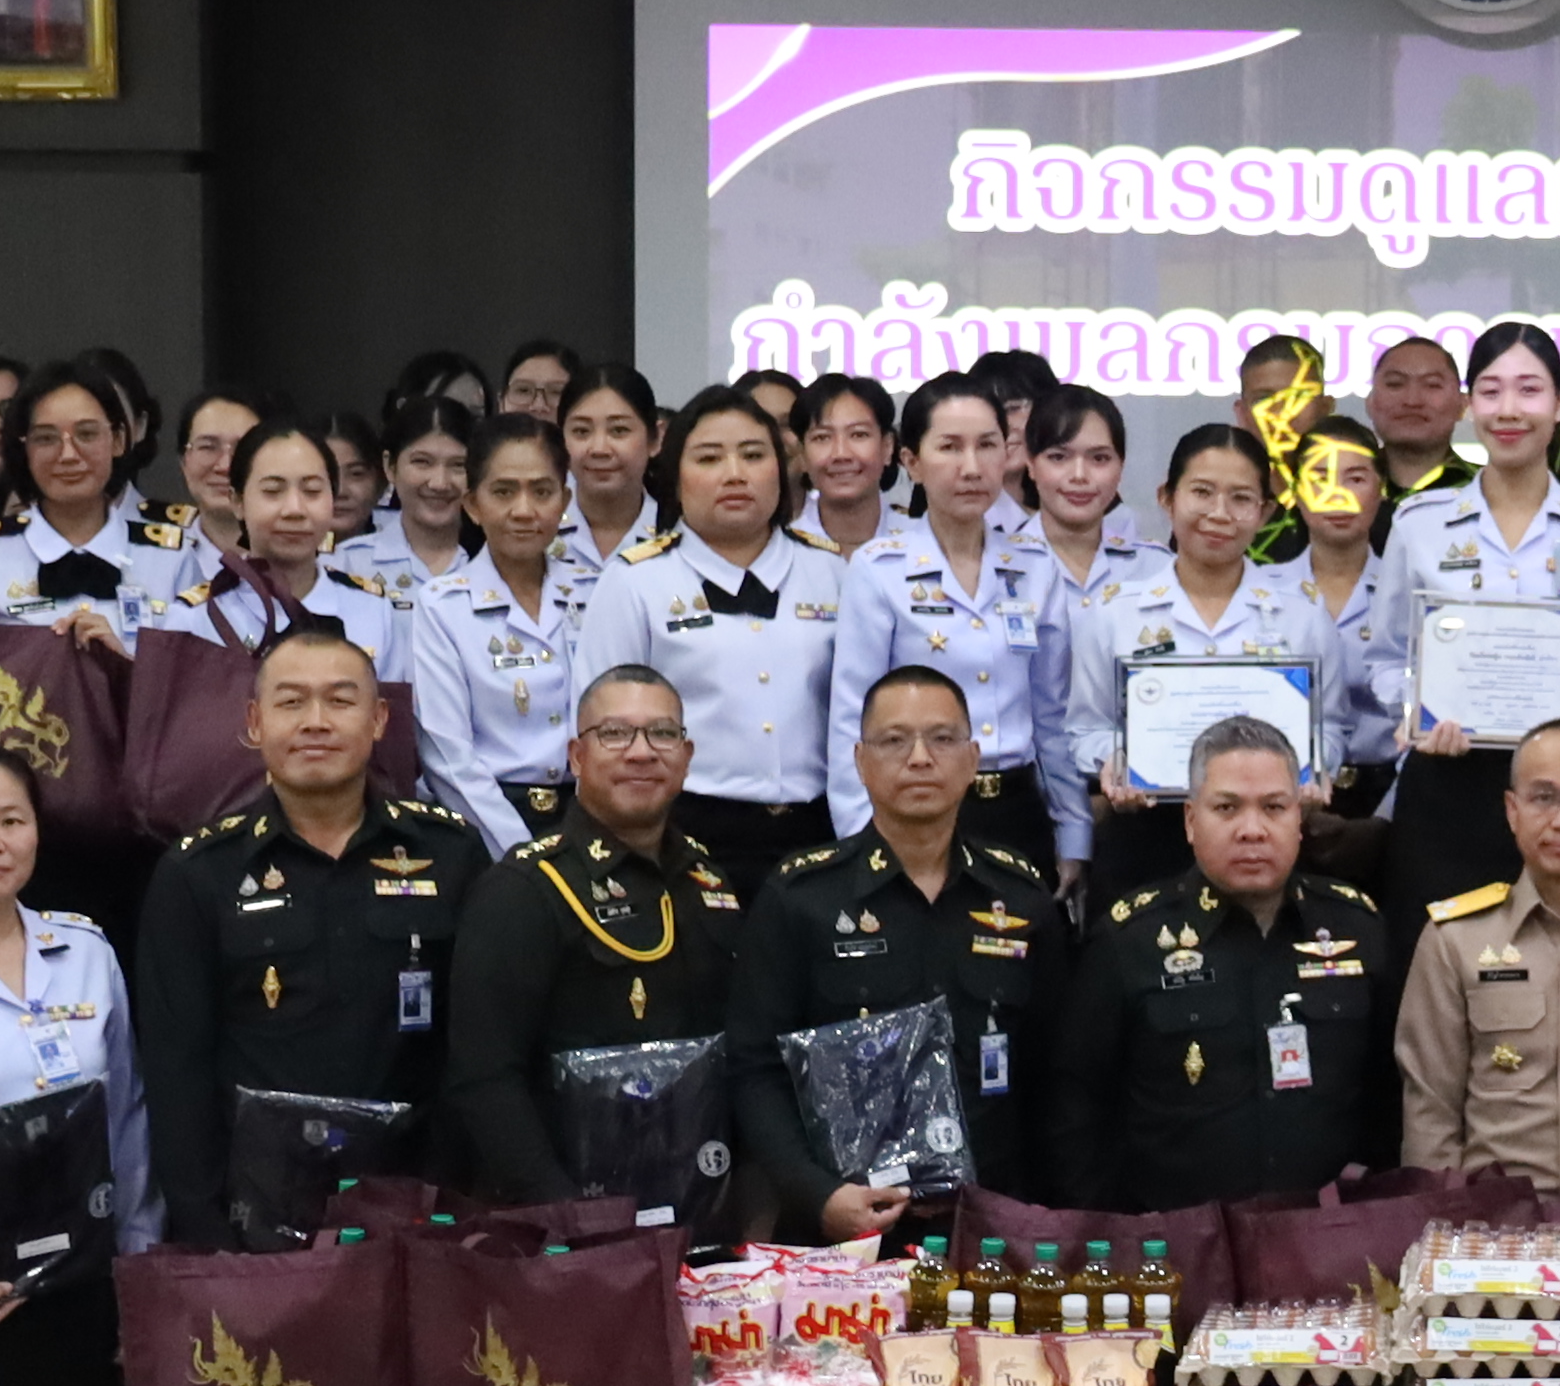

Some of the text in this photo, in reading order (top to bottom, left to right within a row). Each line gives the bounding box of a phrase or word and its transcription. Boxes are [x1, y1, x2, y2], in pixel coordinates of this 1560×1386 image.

[689, 1309, 764, 1351] าม่า
[795, 1292, 892, 1344] มาม่า
[1340, 1335, 1349, 1347] 2
